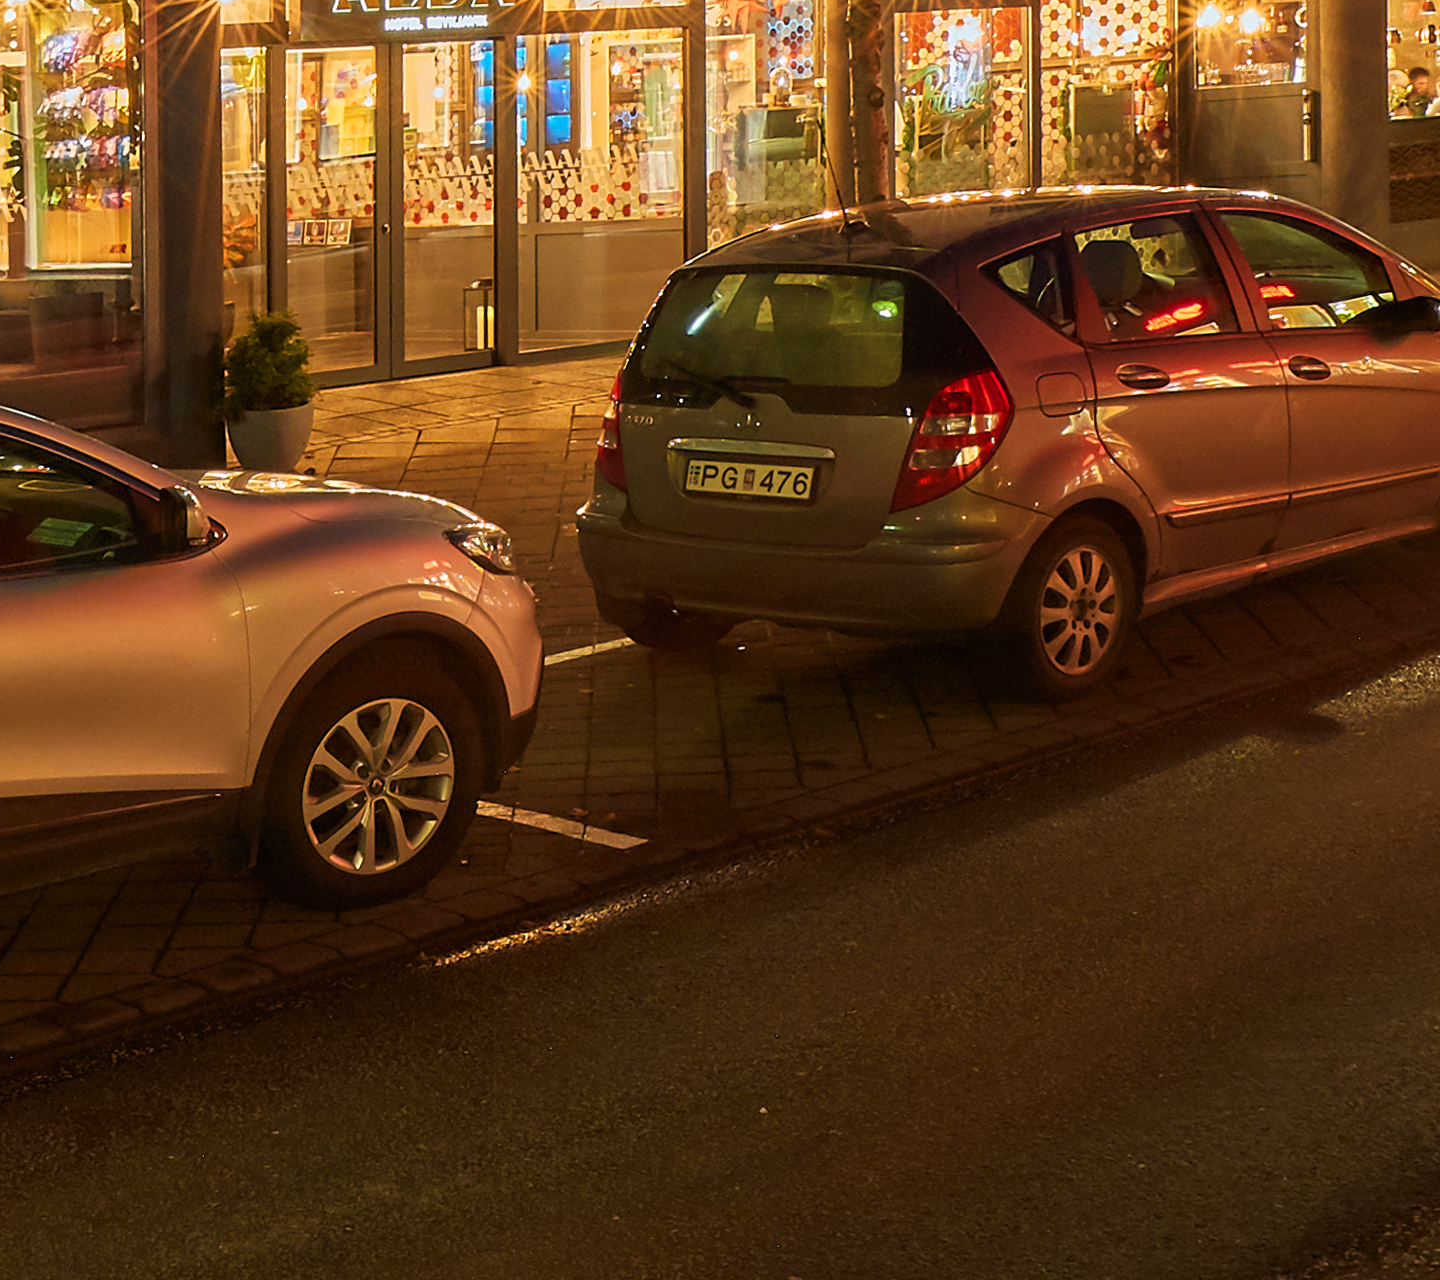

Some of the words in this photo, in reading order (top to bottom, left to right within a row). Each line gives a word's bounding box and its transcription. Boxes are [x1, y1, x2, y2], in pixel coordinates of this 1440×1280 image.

[385, 17, 423, 31] HOTEL
[427, 14, 488, 30] REYKJAVIK
[700, 465, 738, 490] PG
[760, 470, 809, 495] 476
